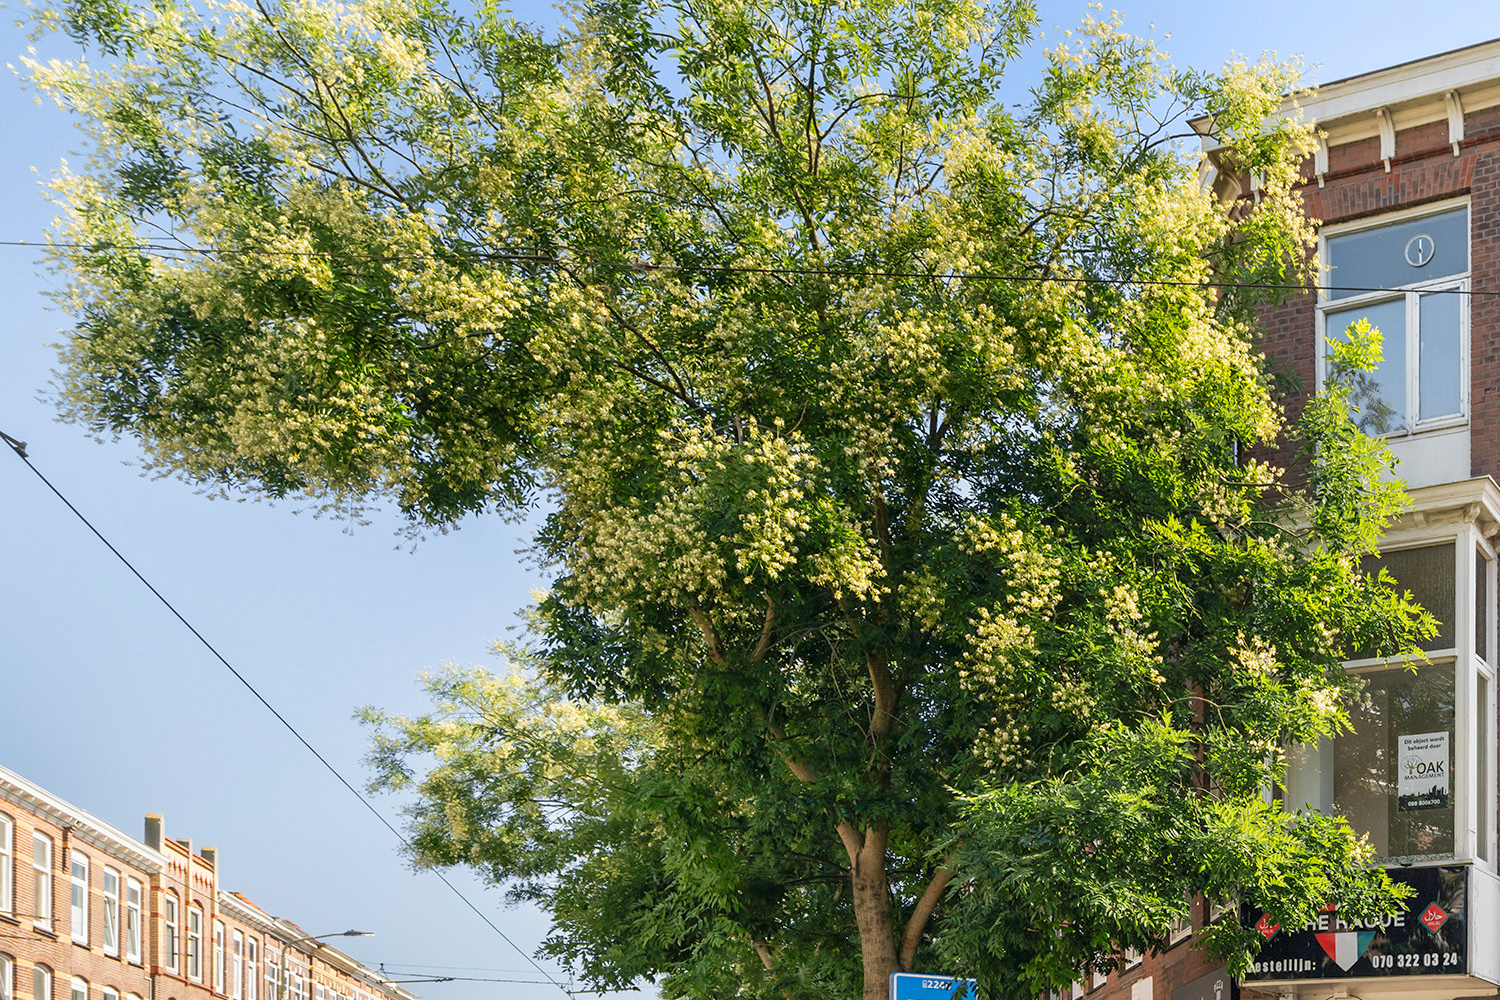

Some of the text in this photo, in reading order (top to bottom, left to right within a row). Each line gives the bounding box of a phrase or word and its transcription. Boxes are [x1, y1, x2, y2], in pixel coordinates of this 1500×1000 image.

[1416, 761, 1444, 774] OAK
[1424, 910, 1443, 922] حلال
[1372, 953, 1394, 969] 070
[1398, 954, 1419, 968] 322
[1424, 953, 1438, 966] 03
[1442, 952, 1458, 966] 24
